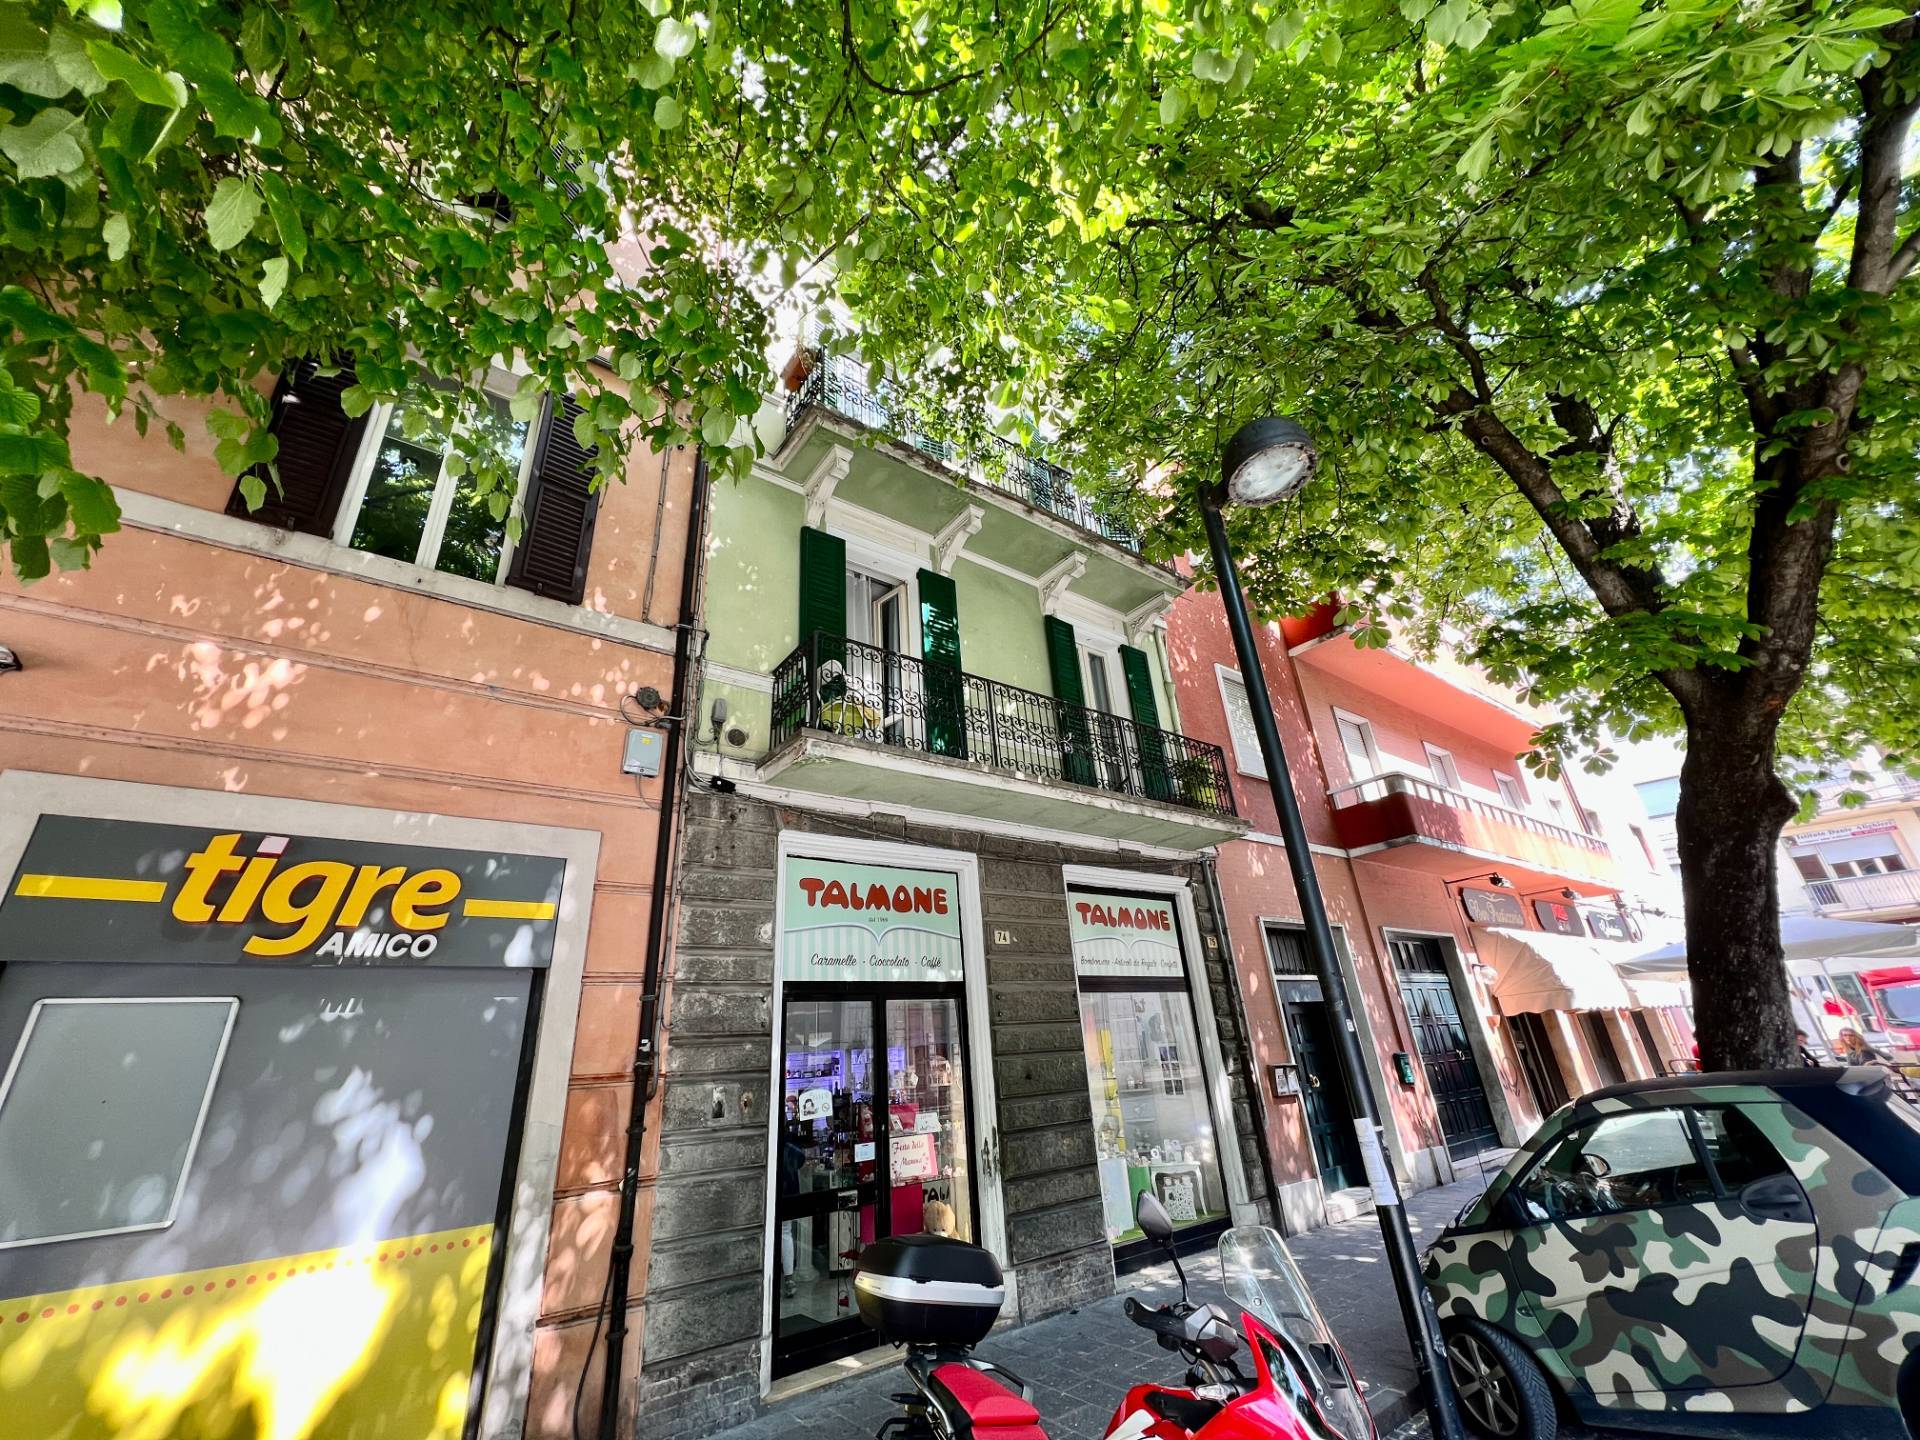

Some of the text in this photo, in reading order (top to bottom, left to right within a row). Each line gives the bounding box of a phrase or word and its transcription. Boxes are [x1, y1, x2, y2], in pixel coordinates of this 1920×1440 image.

[172, 833, 462, 958] tigre
[799, 877, 949, 915] TALMONE
[1075, 902, 1171, 931] TALMONE
[317, 931, 439, 959] AMICO
[997, 932, 1007, 942] 74
[810, 953, 857, 967] Caramelle
[869, 954, 910, 968] Cioccolato
